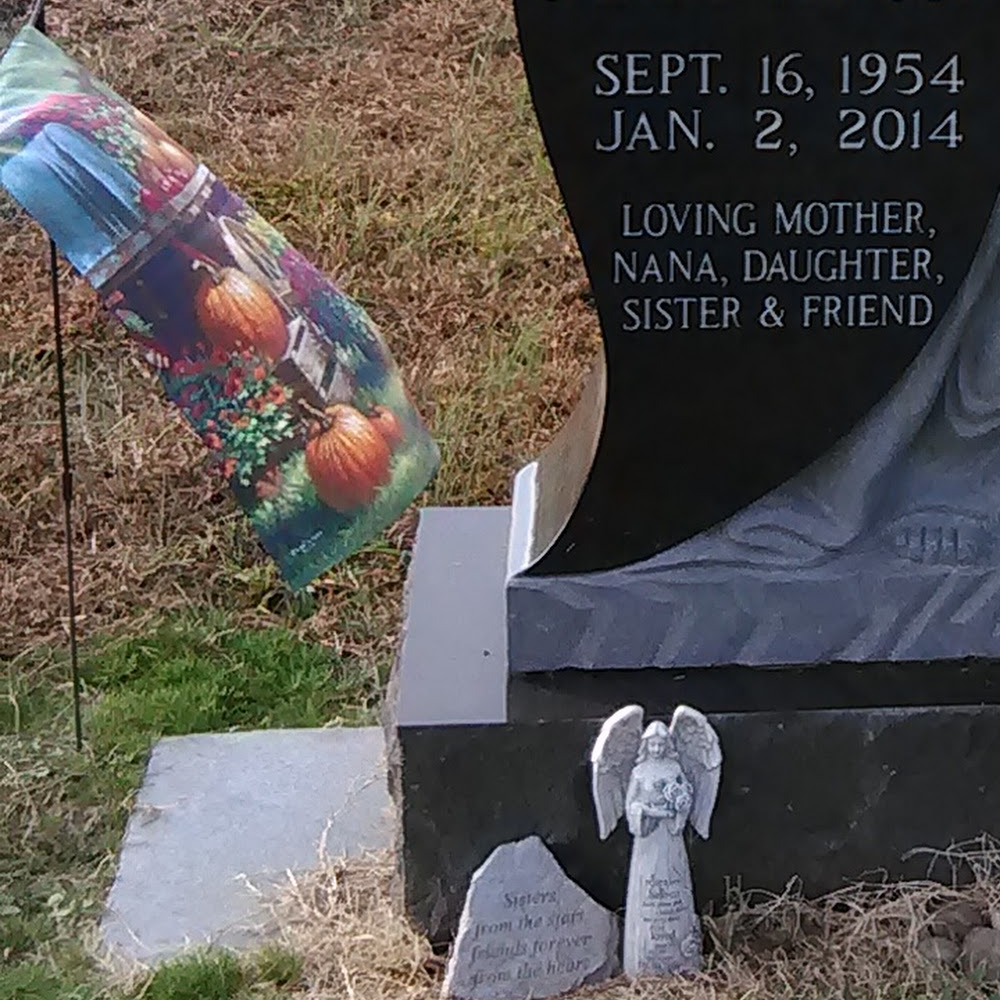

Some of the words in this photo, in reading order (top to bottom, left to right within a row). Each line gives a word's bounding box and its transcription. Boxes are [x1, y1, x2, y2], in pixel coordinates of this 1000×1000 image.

[594, 53, 728, 96] SEPT.
[760, 53, 814, 100] 16,
[841, 53, 965, 96] 1954
[595, 109, 714, 151] JAN.
[755, 109, 798, 157] 2,
[839, 108, 964, 150] 2014
[622, 203, 756, 237] LOVING
[775, 202, 937, 239] MOTHER,
[614, 251, 728, 286] NANA,
[743, 248, 943, 285] DAUGHTER,
[622, 297, 740, 331] SISTER
[759, 296, 785, 328] &
[803, 294, 933, 327] FRIEND
[517, 913, 543, 931] the
